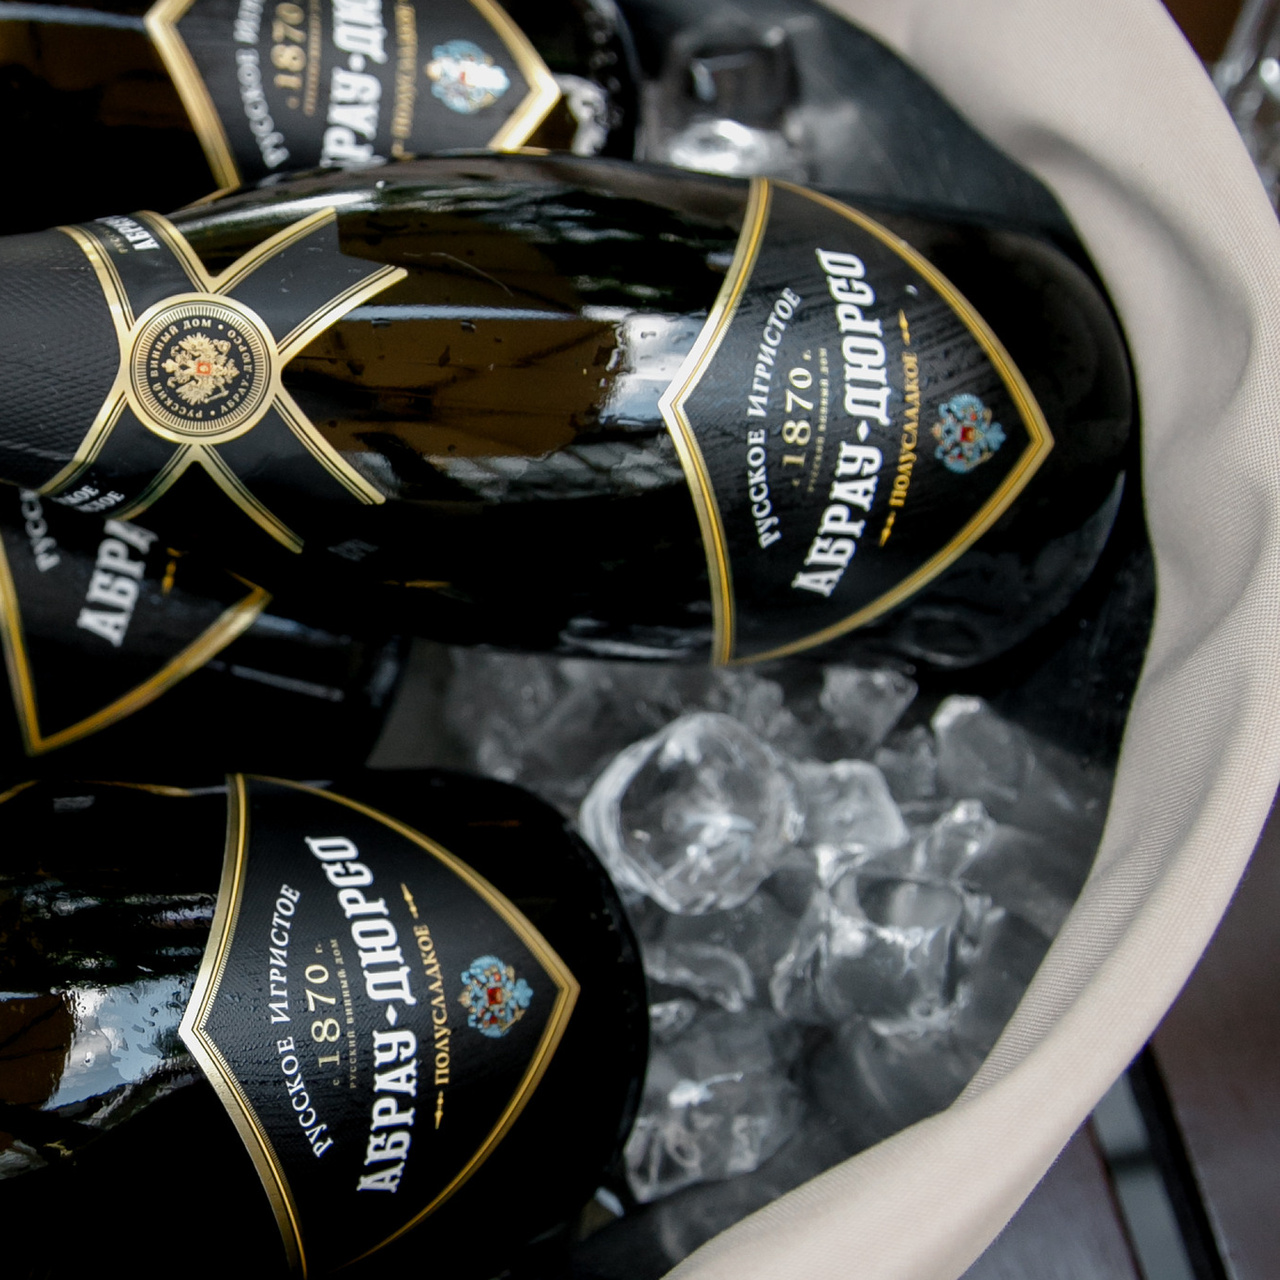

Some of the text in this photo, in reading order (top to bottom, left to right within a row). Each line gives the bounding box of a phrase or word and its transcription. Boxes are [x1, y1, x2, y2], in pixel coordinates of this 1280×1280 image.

[270, 2, 306, 90] 1870
[182, 317, 213, 331] ДОМ
[746, 287, 802, 549] РУССКОЕ ИГРИСТОЕ
[782, 366, 813, 468] 1870
[888, 352, 922, 508] ПОЛУСЛАДКОЕ
[330, 938, 345, 965] ДОМ
[269, 883, 335, 1158] РУССКОЕ ИГРИСТОЕ
[304, 963, 341, 1068] 1870
[412, 923, 452, 1086] ПОЛУСЛАДКОЕ
